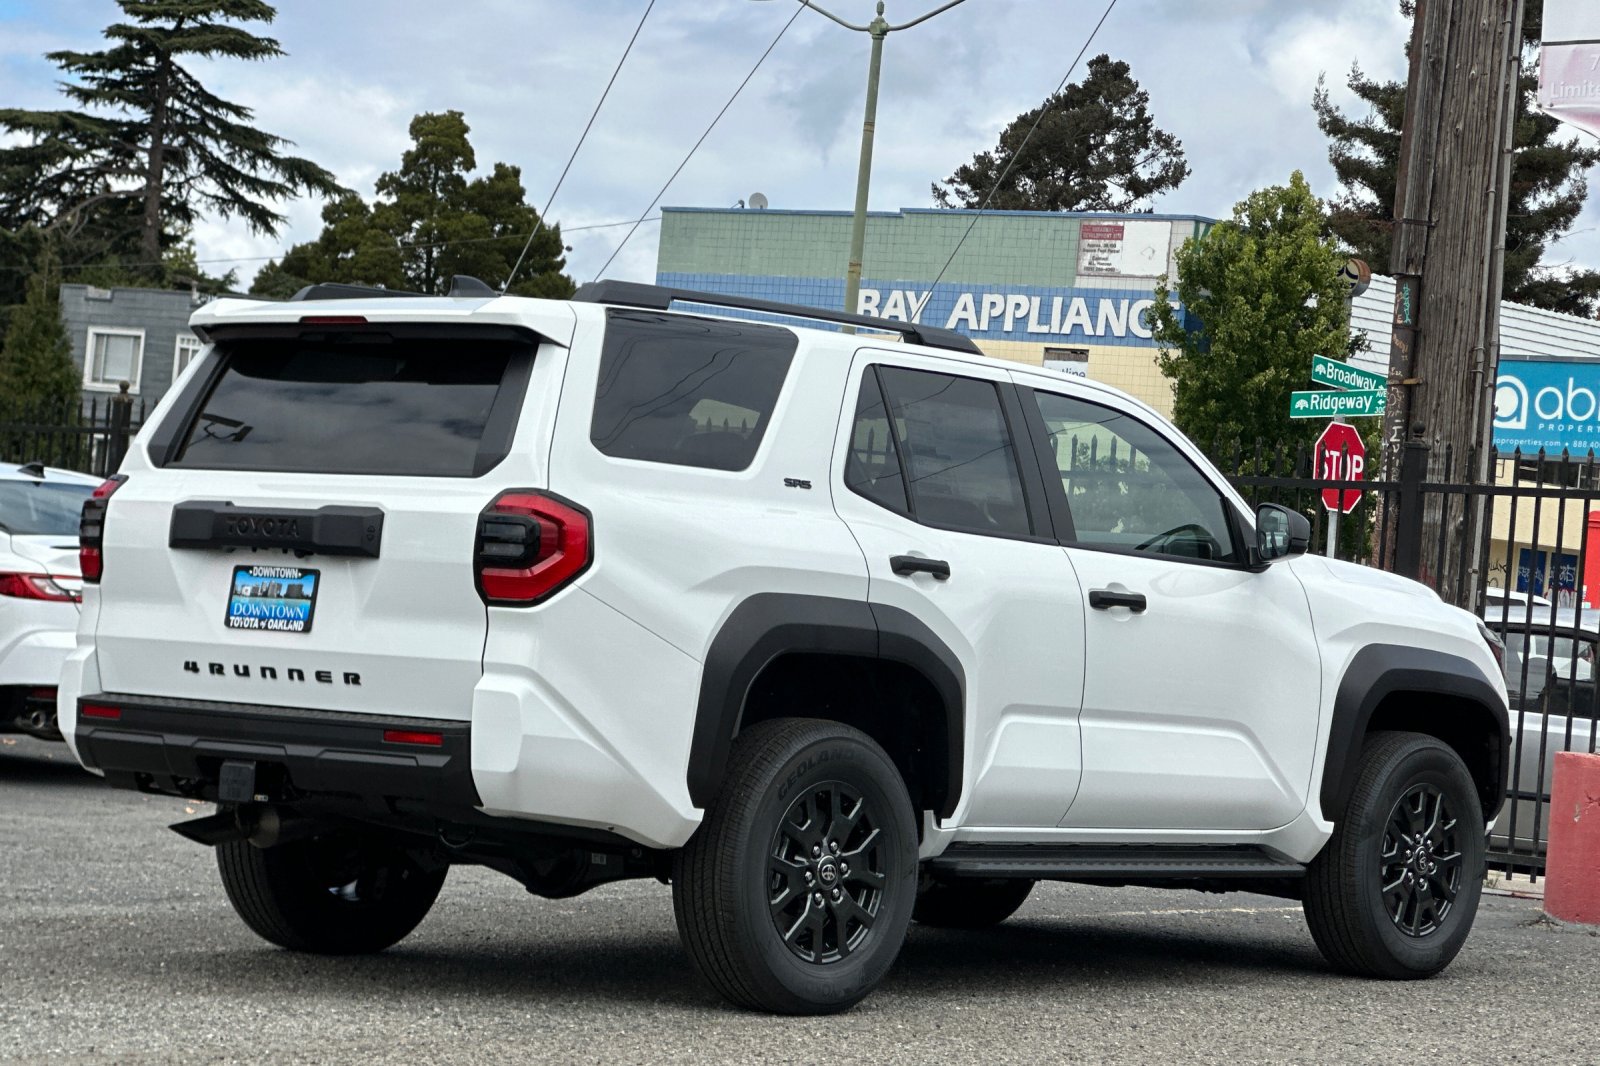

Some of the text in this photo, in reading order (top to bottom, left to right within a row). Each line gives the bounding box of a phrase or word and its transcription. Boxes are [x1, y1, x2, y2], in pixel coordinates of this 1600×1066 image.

[856, 288, 1182, 339] BAY APPLIANC
[1326, 362, 1376, 390] Broadway
[1310, 394, 1373, 414] Ridgeway
[1534, 377, 1600, 421] ab
[225, 516, 300, 538] TOYOTA
[252, 566, 298, 579] DOWNTOWN
[233, 602, 305, 619] DOWNTOWN
[229, 616, 259, 629] TOYOTA
[267, 619, 305, 632] OAKLAND
[183, 660, 362, 686] 4RUNNER
